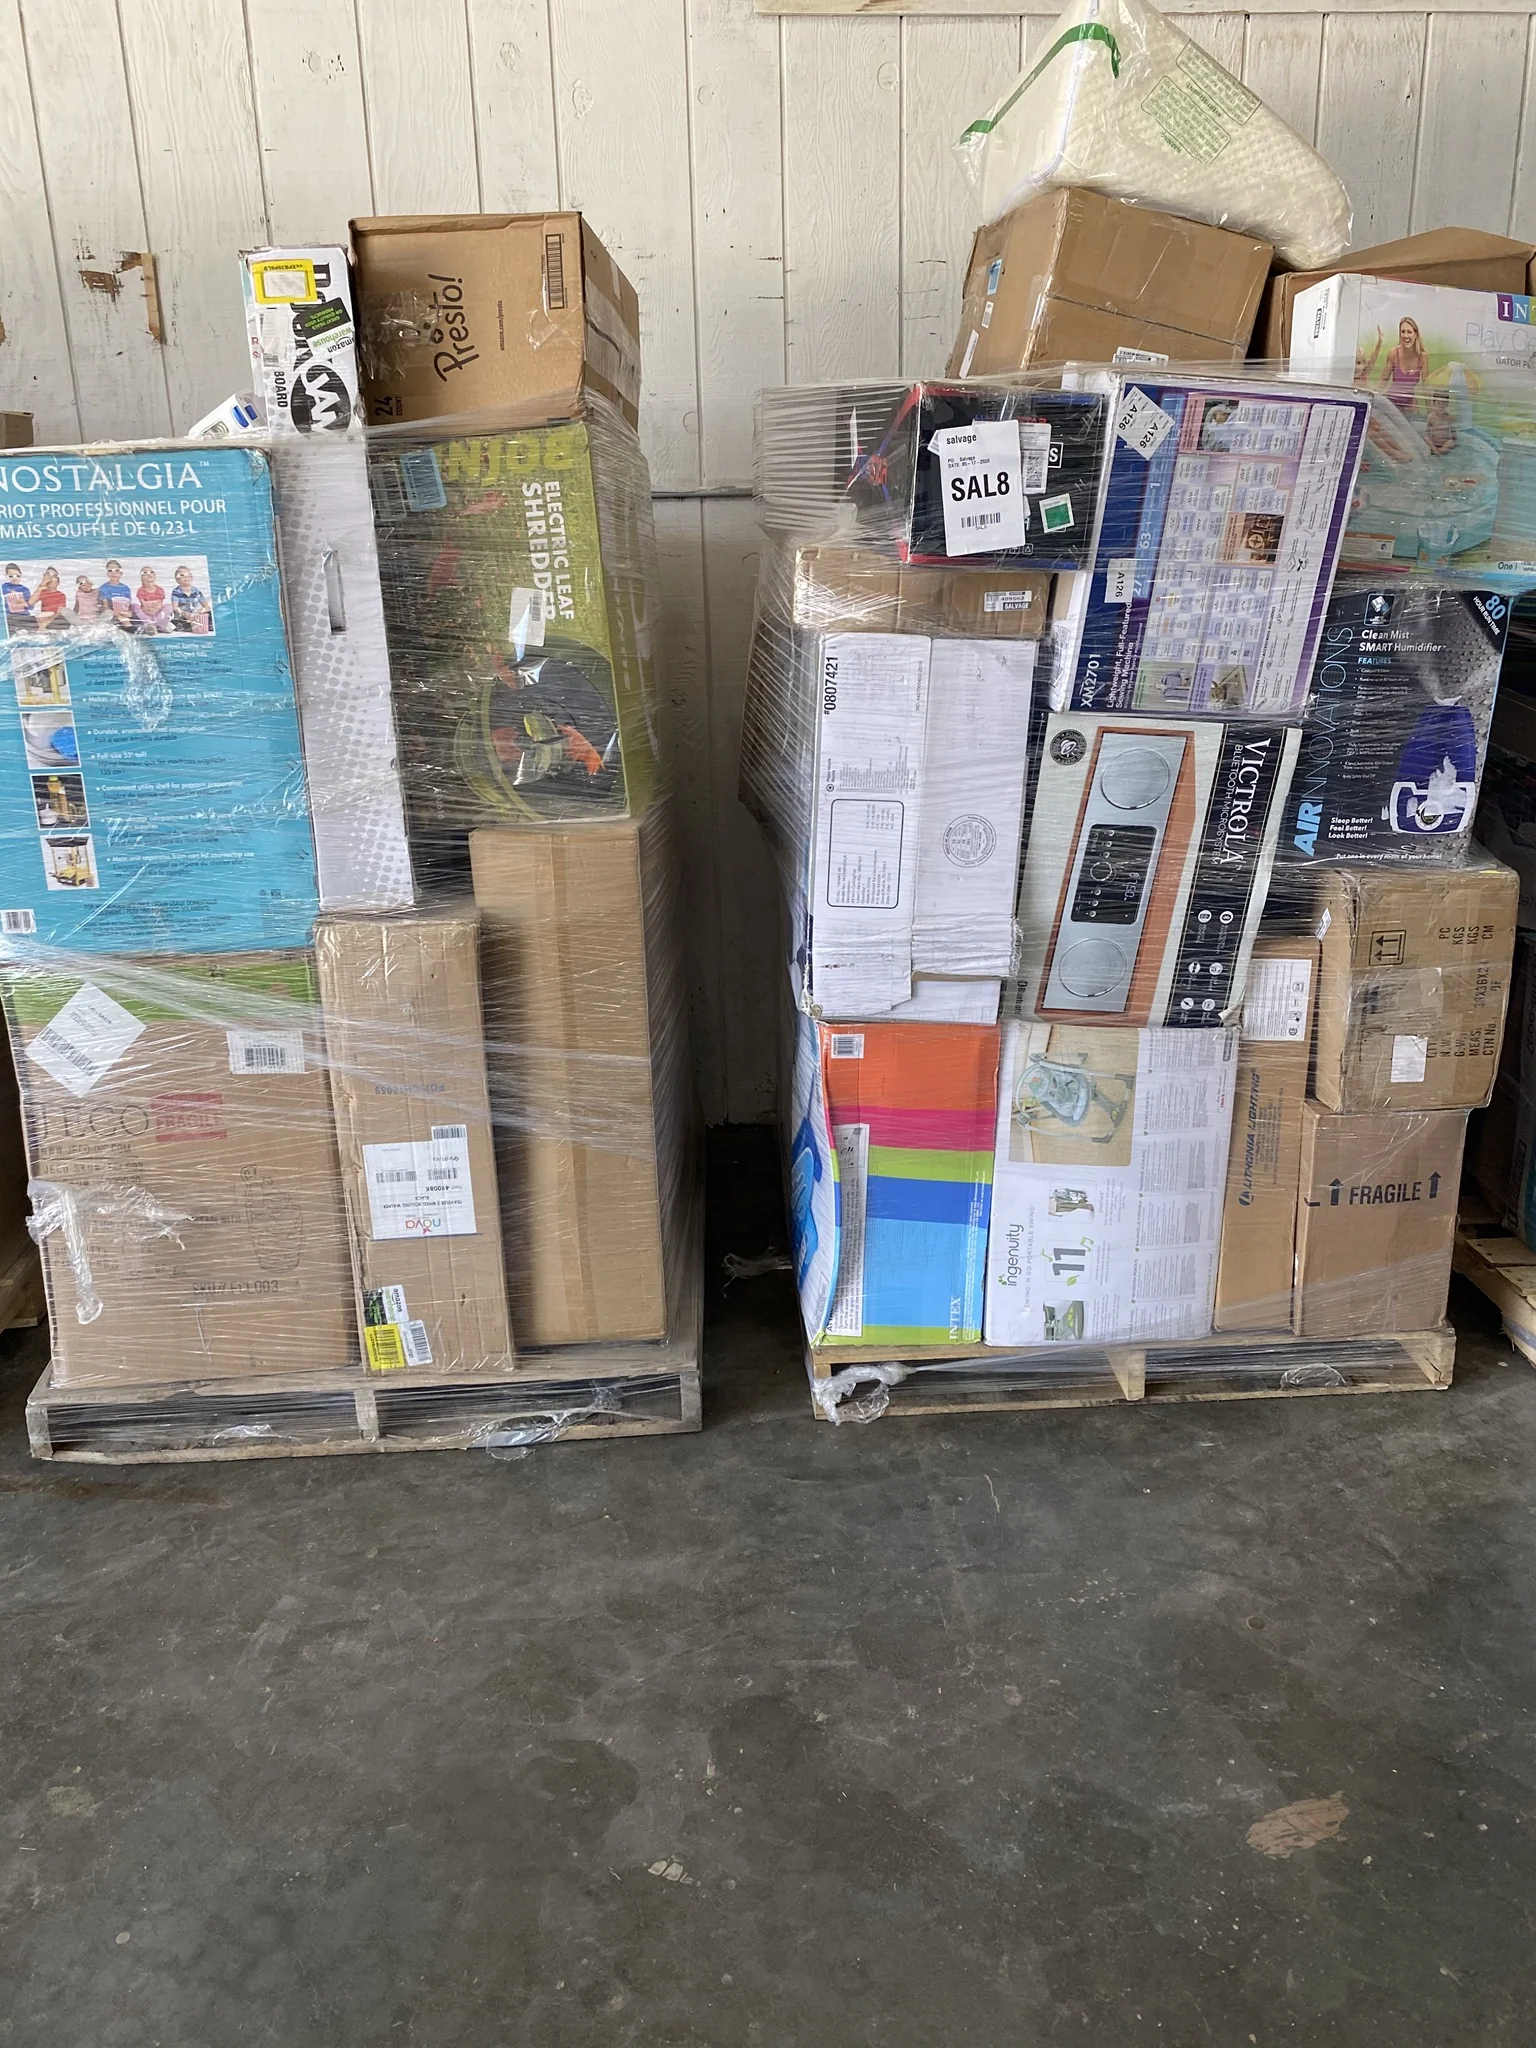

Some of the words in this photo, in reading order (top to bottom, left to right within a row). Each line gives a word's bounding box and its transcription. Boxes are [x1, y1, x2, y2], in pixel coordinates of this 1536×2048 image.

[313, 327, 354, 347] warehouse
[428, 274, 480, 382] Presto!
[1465, 322, 1506, 352] Play
[1496, 356, 1521, 368] GATOR
[274, 371, 293, 408] BOARD
[375, 396, 393, 416] 24
[396, 396, 404, 416] COUNT
[1118, 404, 1138, 430] A126
[946, 434, 977, 445] salvage
[1140, 423, 1159, 448] A126
[951, 472, 1010, 501] SAL8
[40, 501, 177, 519] PROFESSIONNEL
[181, 499, 226, 515] POUR
[0, 522, 42, 539] MAÏS
[46, 519, 120, 538] SOUFFLÉ
[125, 521, 146, 535] DE
[151, 521, 185, 537] 0,23
[189, 520, 199, 535] L
[545, 481, 569, 569] ELECTRIC
[1139, 533, 1151, 549] 63
[1498, 562, 1513, 571] One
[556, 574, 575, 620] LEAF
[1116, 572, 1125, 597] A126
[1005, 602, 1029, 610] SALVAGE
[1472, 596, 1486, 613] HOUR
[1489, 621, 1501, 636] TIME
[1485, 595, 1506, 620] 80
[1358, 642, 1393, 652] SMART
[1393, 642, 1442, 652] Humidifier
[1361, 629, 1388, 640] Clean
[1390, 630, 1409, 640] Mist
[1107, 659, 1123, 708] Lightweight,
[1116, 602, 1132, 658] Full-Featured
[1122, 642, 1134, 677] Machine
[824, 656, 839, 716] #0807421
[1080, 654, 1101, 708] XM2701
[1116, 678, 1129, 708] Sewing
[1224, 744, 1243, 799] BLUETOOTH
[1220, 738, 1271, 865] VICTROLA
[1210, 801, 1231, 866] MICROSYSTEM
[1330, 817, 1349, 825] Sleep
[1438, 927, 1450, 940] PC
[1452, 927, 1465, 946] KGS
[1466, 926, 1479, 945] KGS
[1469, 1027, 1482, 1057] MEAS:
[1482, 925, 1494, 940] CM
[1482, 1037, 1494, 1057] CTN
[1248, 1073, 1260, 1131] LIGHTING
[1243, 1134, 1255, 1189] LITHONIA
[1349, 1182, 1422, 1206] FRAGILE
[406, 1218, 441, 1230] nova
[1004, 1224, 1024, 1286] ingenuity
[1052, 1247, 1086, 1277] 11
[393, 1288, 403, 1313] amazon
[949, 1295, 962, 1341] INTEX
